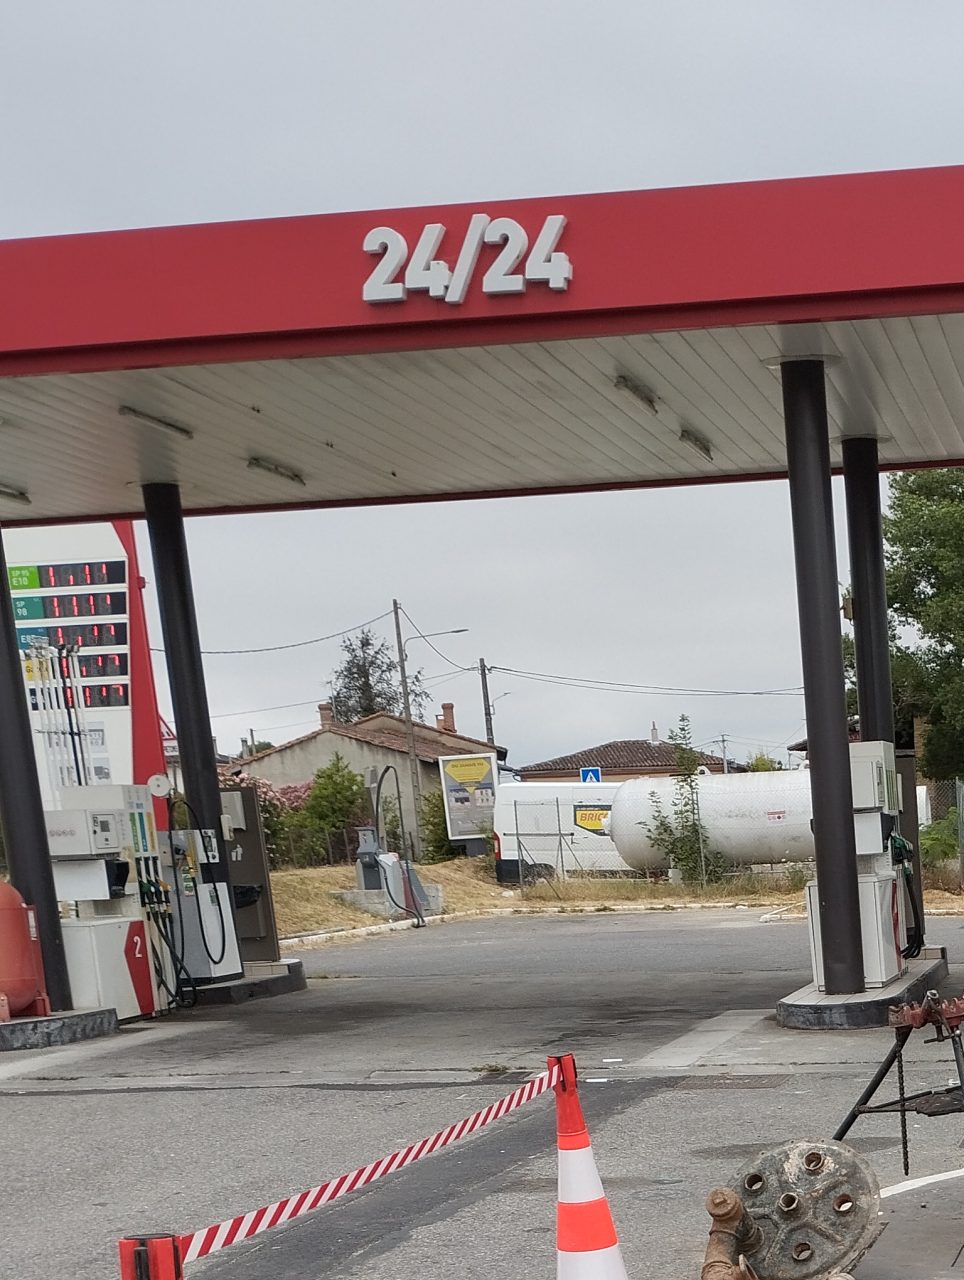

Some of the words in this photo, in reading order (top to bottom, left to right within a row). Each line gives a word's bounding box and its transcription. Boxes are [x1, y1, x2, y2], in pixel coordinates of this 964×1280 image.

[362, 213, 573, 304] 24/24
[12, 577, 28, 586] E10
[133, 936, 142, 958] 2
